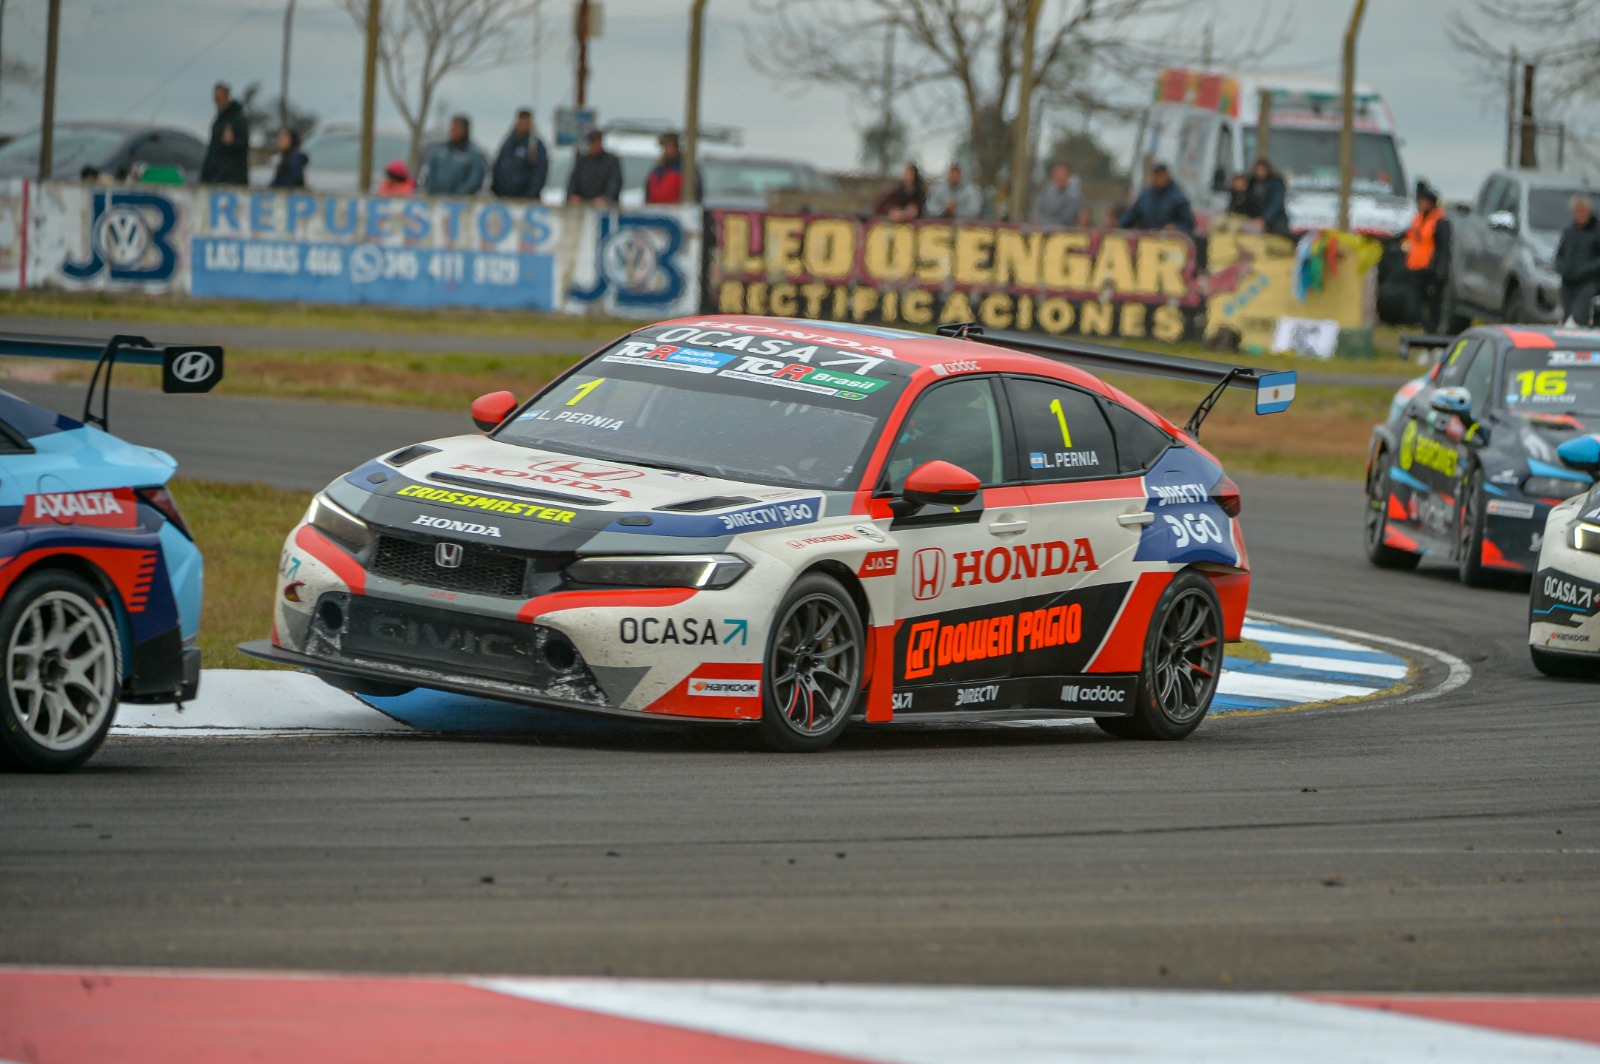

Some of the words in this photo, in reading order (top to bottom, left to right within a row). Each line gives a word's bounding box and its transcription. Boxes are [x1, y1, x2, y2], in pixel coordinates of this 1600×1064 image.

[208, 191, 551, 244] REPUESTOS
[720, 214, 855, 280] LEO
[865, 221, 1190, 297] OSENGAR
[719, 279, 1185, 343] RECTIFICACIONES
[615, 341, 681, 360] TCR
[654, 327, 821, 364] OCASA
[695, 320, 898, 360] HONDA
[735, 355, 815, 382] TCR
[811, 372, 876, 390] Brasil
[1516, 369, 1567, 396] 16
[565, 378, 607, 406] 1
[556, 411, 624, 431] PERNIA
[1050, 398, 1072, 448] 1
[1055, 450, 1100, 468] PERNIA
[450, 463, 634, 498] HONDA
[1150, 483, 1208, 507] DIRECTV
[34, 491, 123, 519] AXALTA
[396, 484, 577, 524] CROSSMASTER
[412, 515, 502, 538] HONDA
[801, 533, 858, 545] HONDA
[865, 556, 895, 571] JAS
[952, 537, 1099, 588] HONDA
[1544, 575, 1577, 607] OCASA
[620, 617, 718, 646] OCASA
[937, 614, 1015, 667] DOWEN
[955, 685, 1000, 706] DIRECTV
[1079, 685, 1125, 703] addoc
